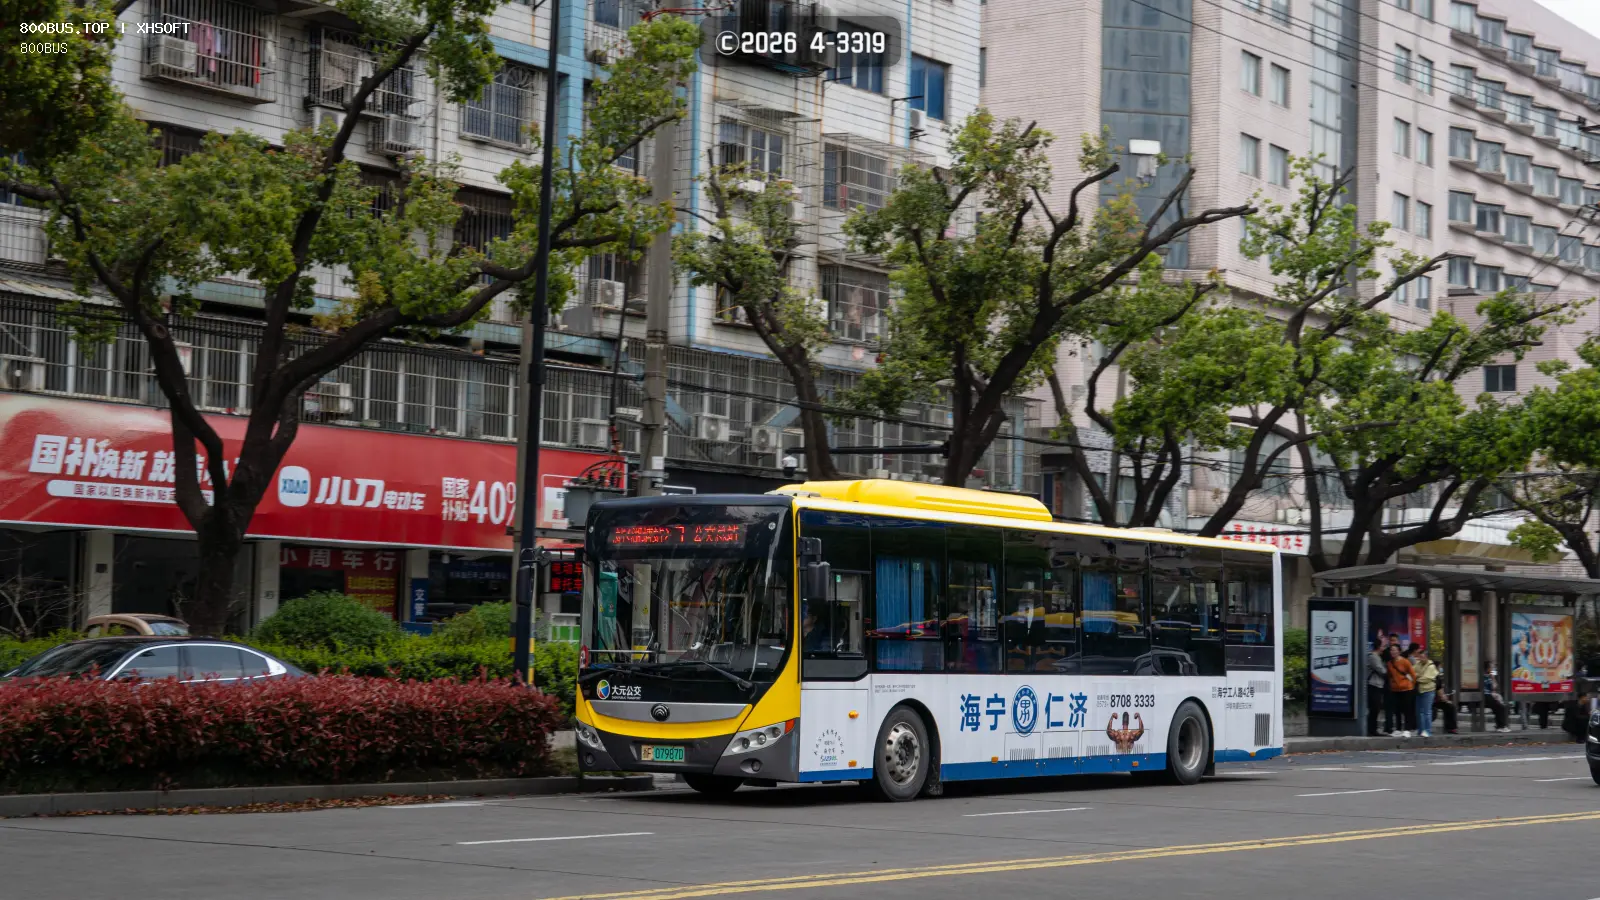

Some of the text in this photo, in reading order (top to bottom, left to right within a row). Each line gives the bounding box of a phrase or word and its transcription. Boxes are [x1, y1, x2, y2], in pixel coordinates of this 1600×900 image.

[28, 434, 148, 480] 国补换新
[315, 476, 426, 511] 小刀 电动车
[442, 476, 469, 499] 国家
[442, 500, 469, 522] 补贴
[280, 547, 397, 571] 小周车行
[611, 684, 642, 697] 大元公交
[1110, 694, 1132, 708] 8708
[1134, 694, 1155, 708] 3333
[959, 692, 1006, 732] 海宁
[1044, 691, 1088, 730] 仁济
